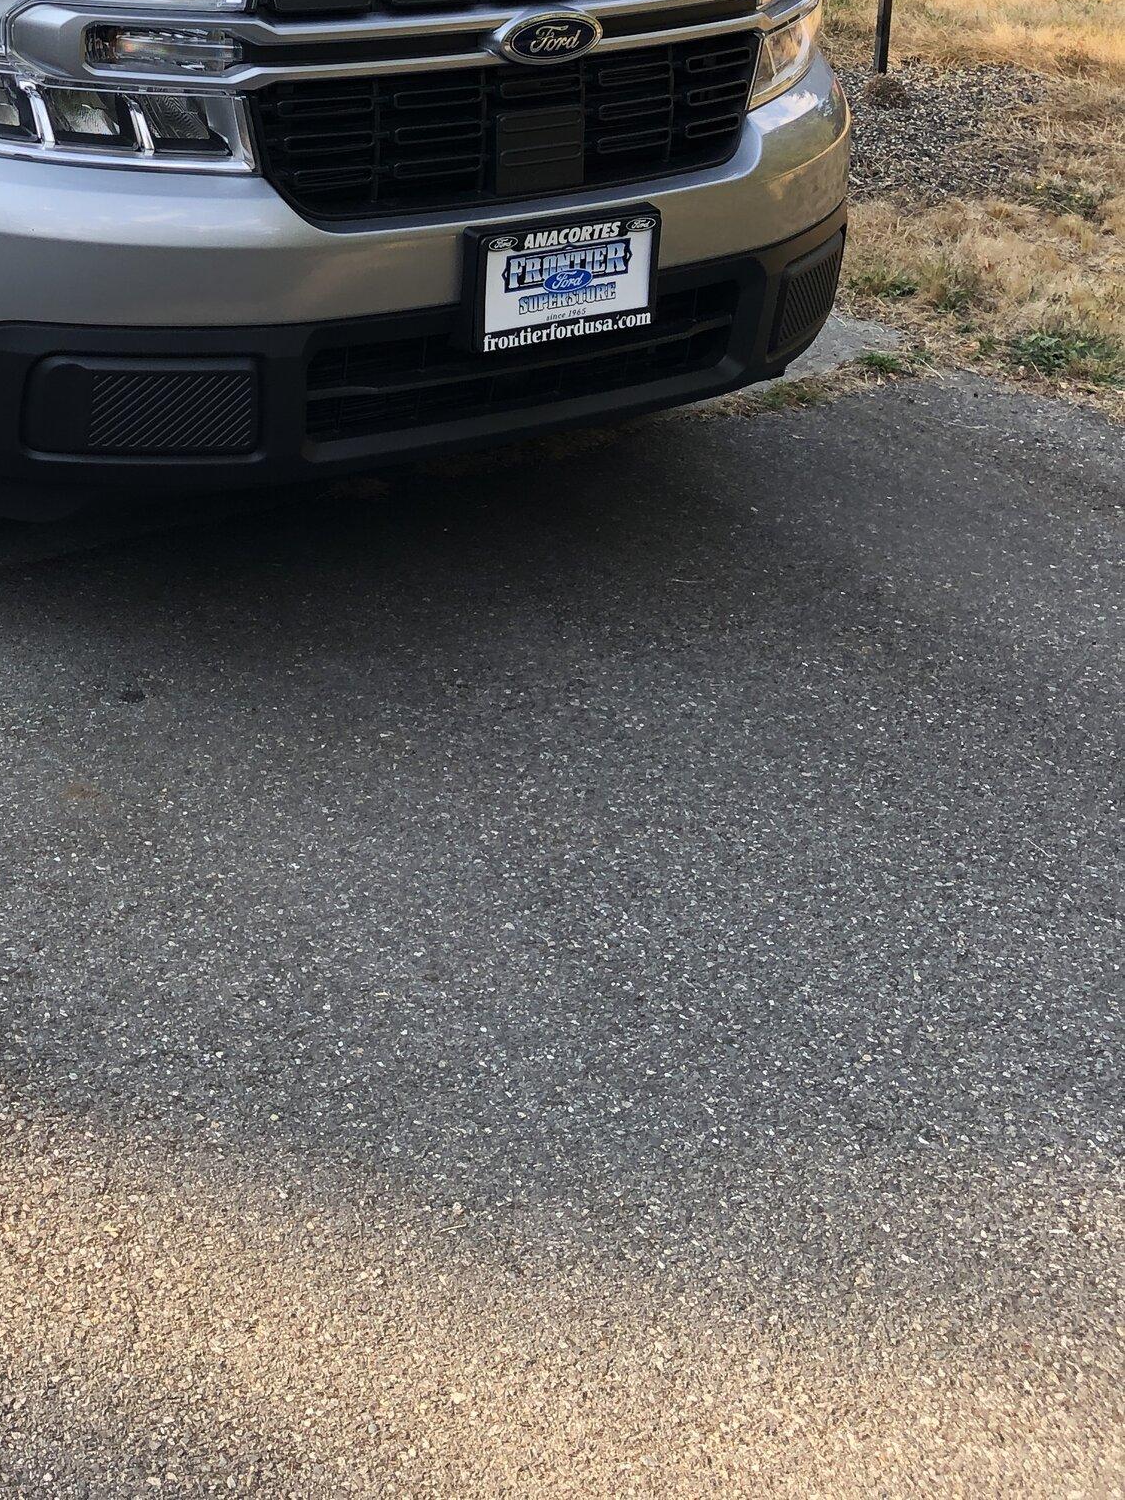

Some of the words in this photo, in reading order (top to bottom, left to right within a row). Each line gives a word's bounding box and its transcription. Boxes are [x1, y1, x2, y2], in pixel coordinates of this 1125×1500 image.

[530, 24, 582, 53] Ford
[524, 221, 621, 250] ANACORTES
[630, 218, 652, 230] Ford
[491, 237, 513, 249] Ford
[508, 242, 627, 289] FRONTIER
[551, 270, 583, 289] Ford
[518, 282, 616, 315] SUPERSTORE
[546, 312, 566, 322] since
[567, 308, 587, 318] 1965
[483, 311, 652, 352] frontierfordusa.com
